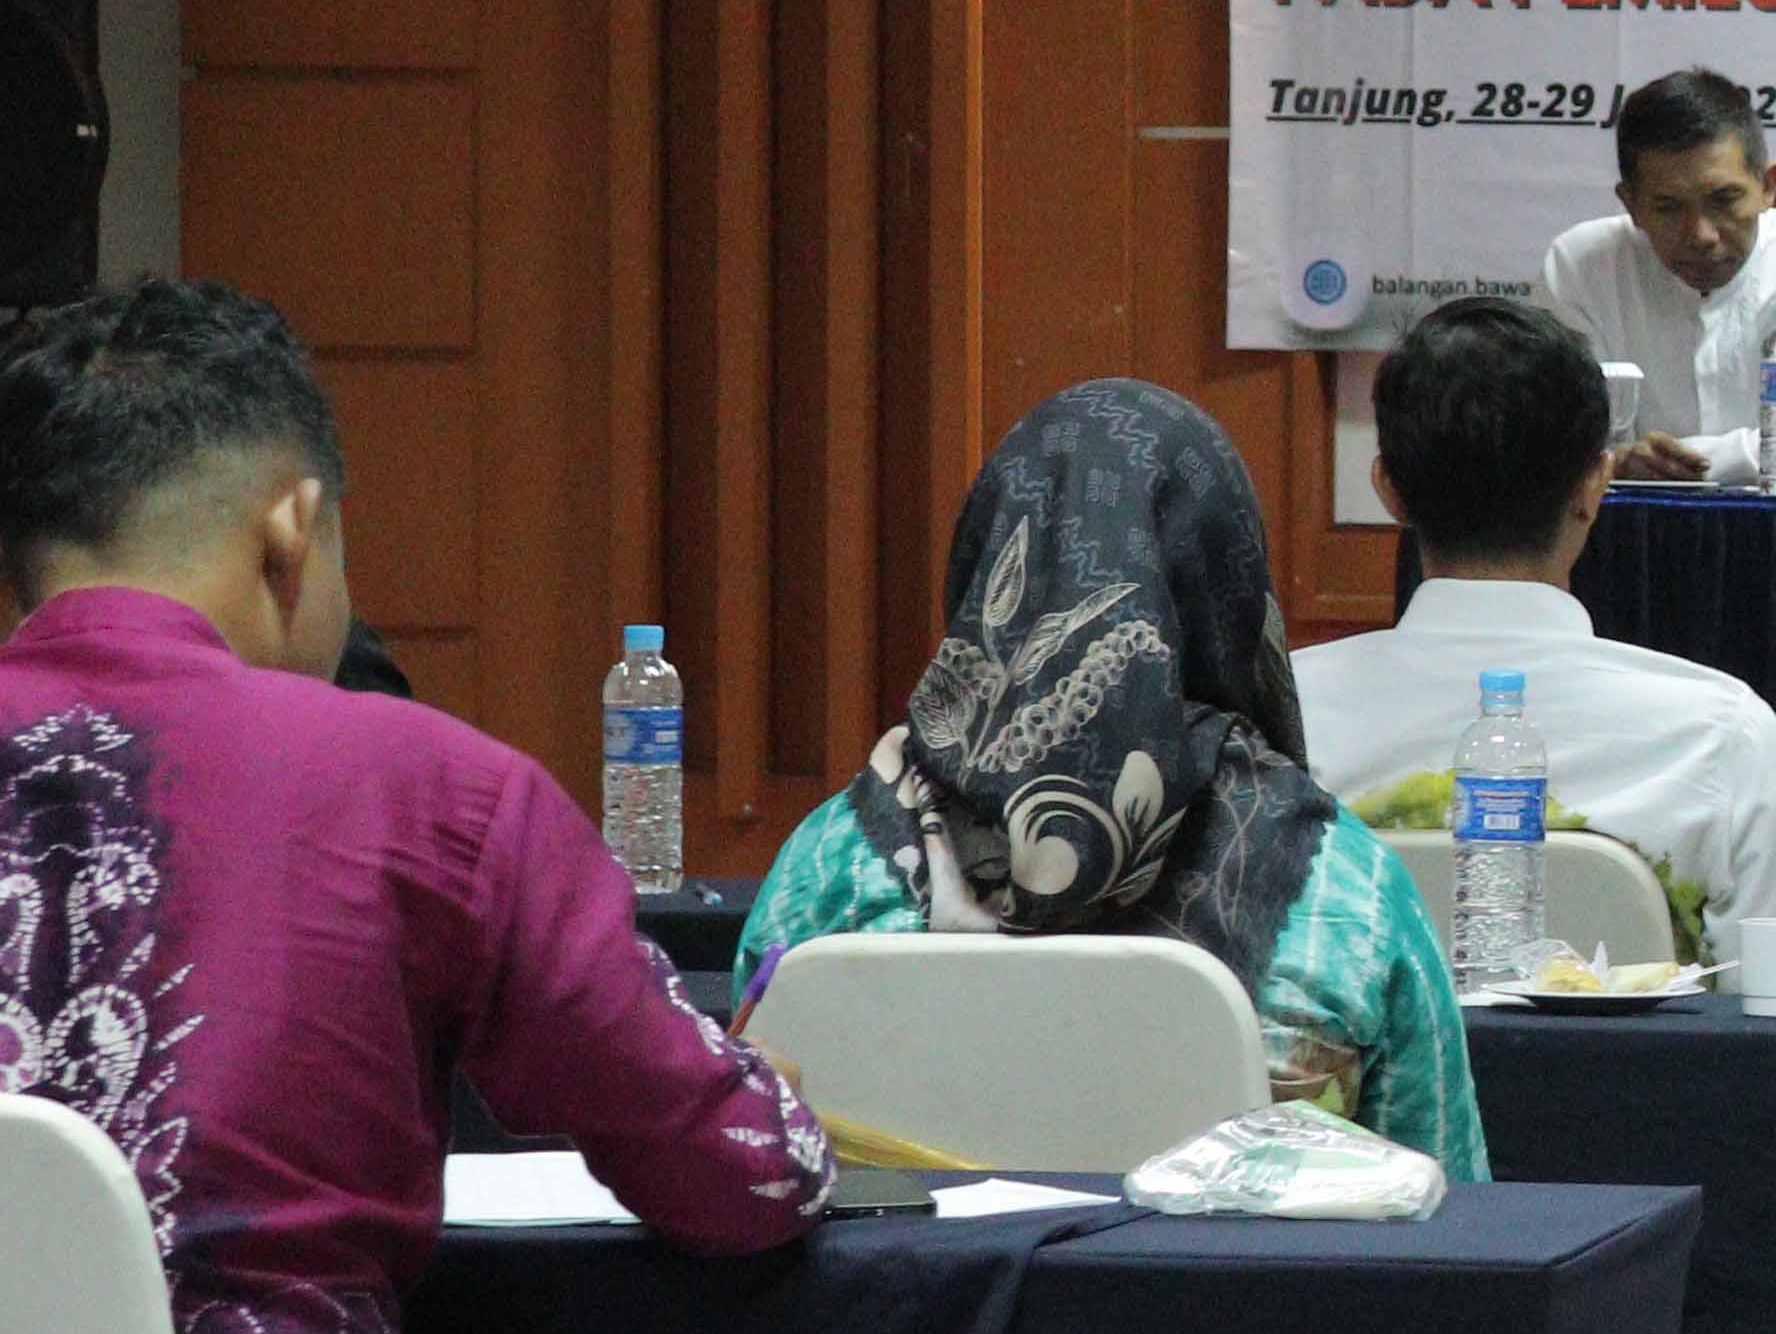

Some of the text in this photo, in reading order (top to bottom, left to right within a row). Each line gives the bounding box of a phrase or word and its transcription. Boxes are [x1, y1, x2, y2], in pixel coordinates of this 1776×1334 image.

[1267, 77, 1455, 127] Tanjung,
[1471, 82, 1595, 118] 28-29
[1371, 275, 1532, 299] balangan.bawa
